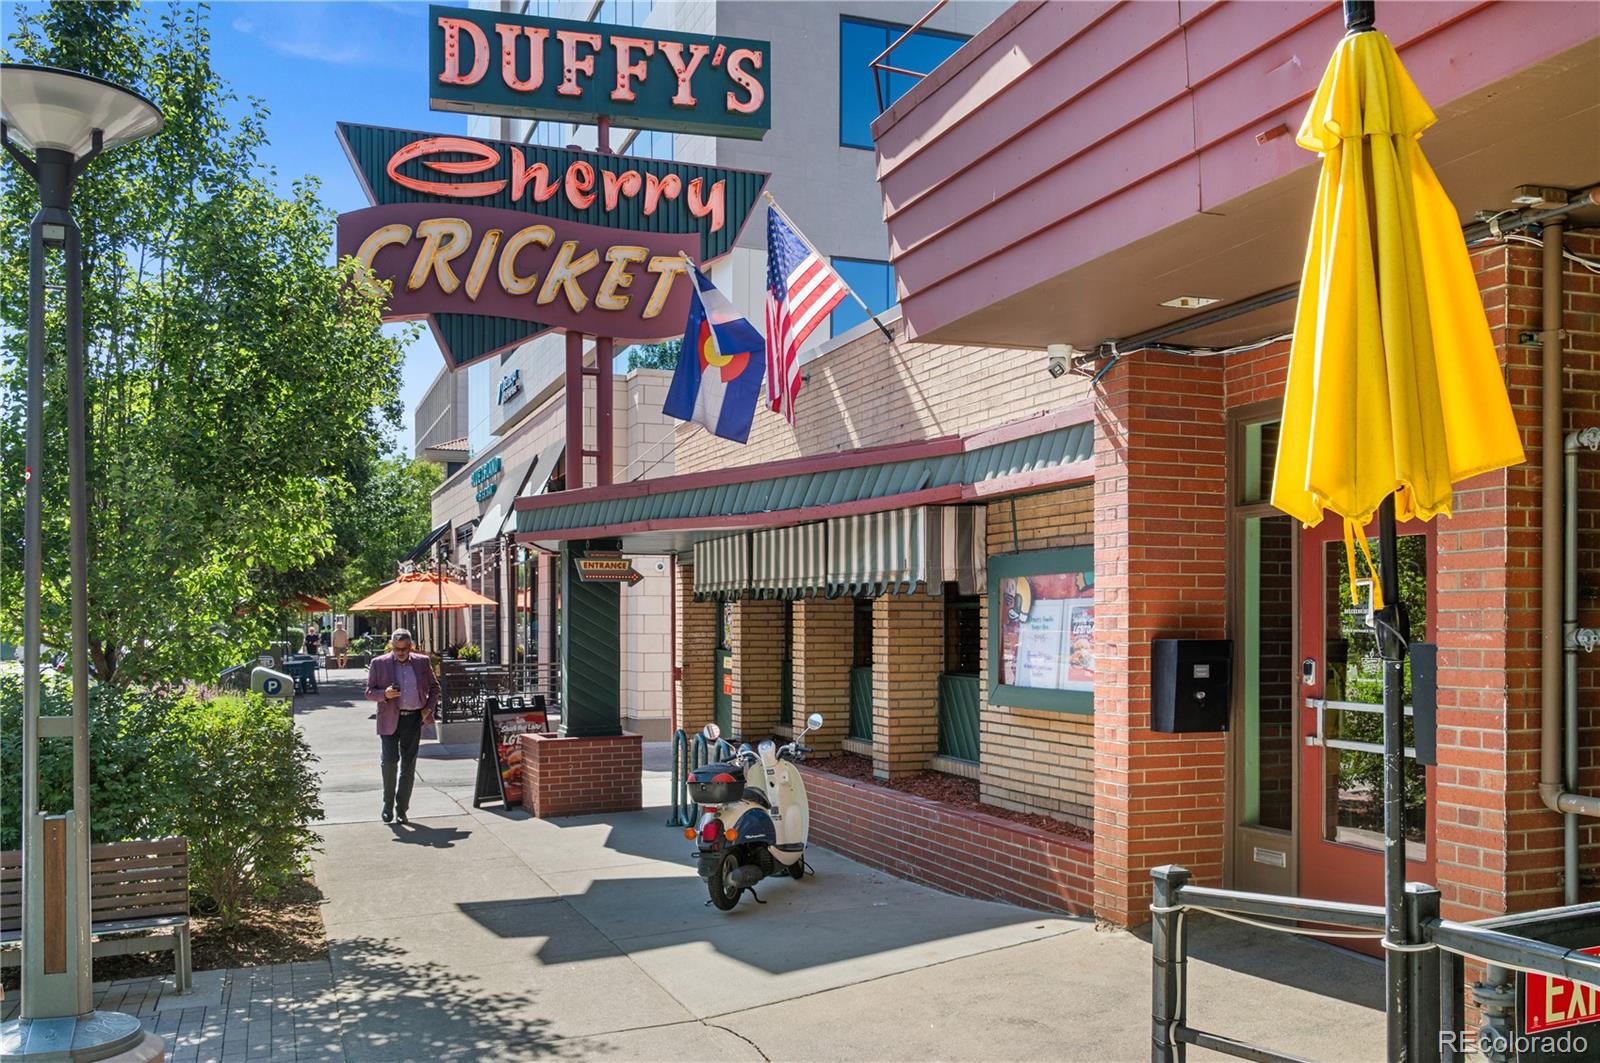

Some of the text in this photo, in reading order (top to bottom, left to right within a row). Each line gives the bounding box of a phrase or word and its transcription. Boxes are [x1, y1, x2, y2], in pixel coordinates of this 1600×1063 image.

[438, 16, 765, 114] DUFFY'S
[386, 136, 726, 233] Cherry
[352, 217, 692, 319] CRICKET
[583, 561, 627, 570] ENTRANCE
[268, 680, 278, 692] P
